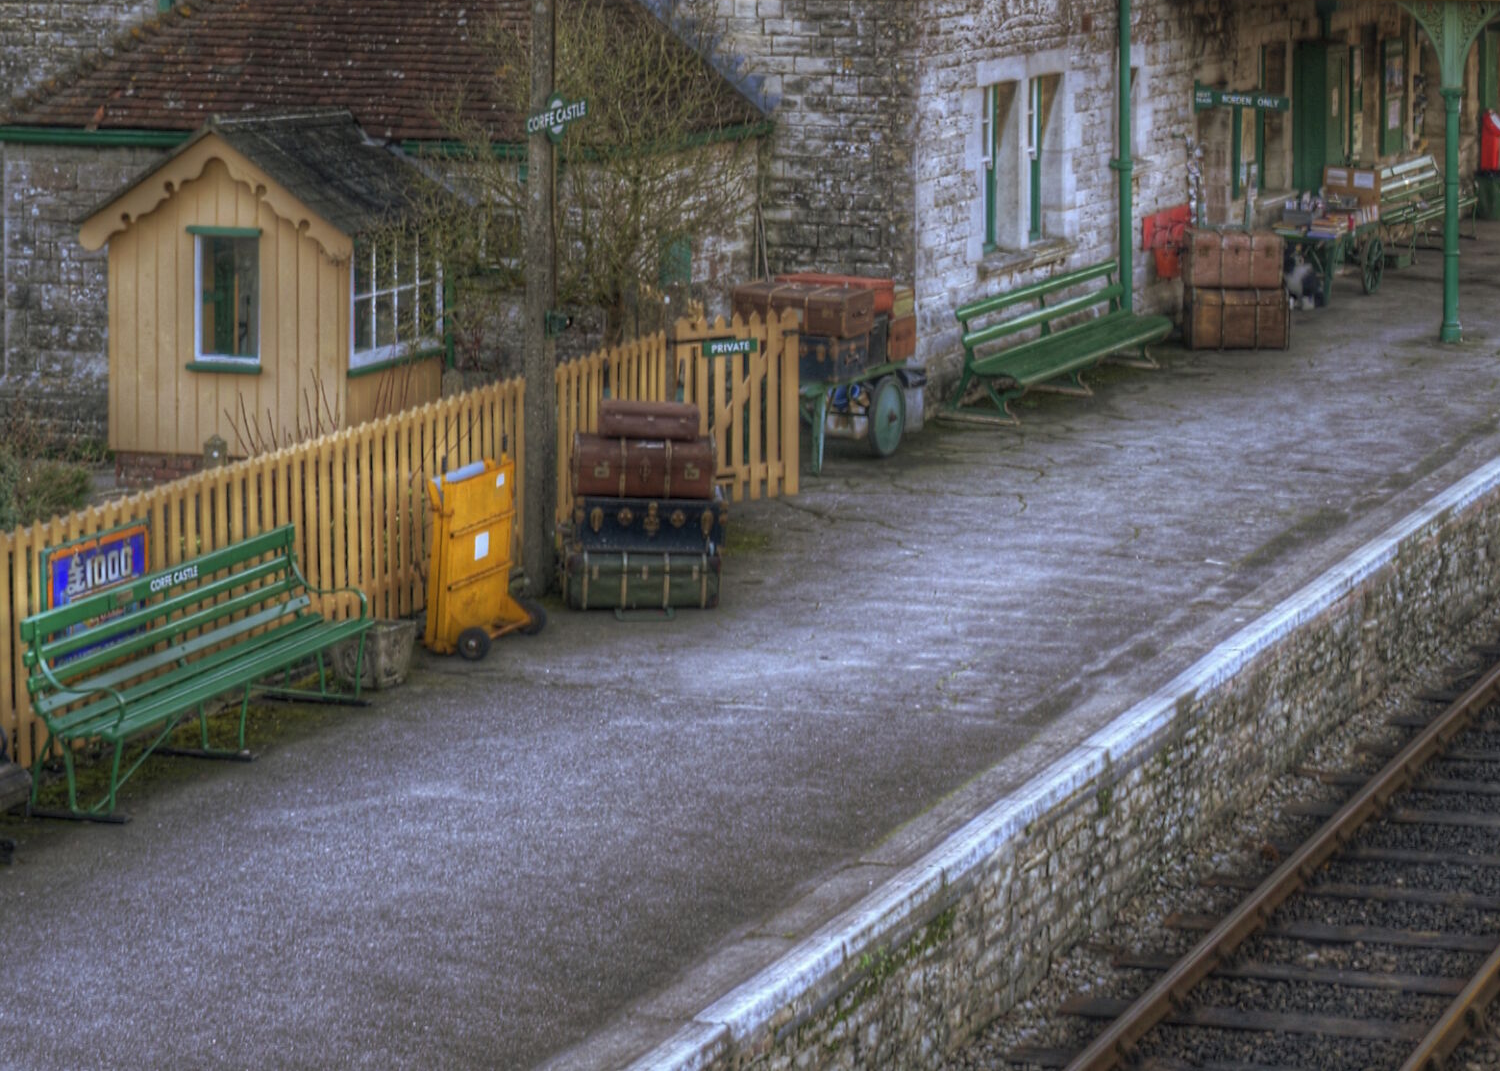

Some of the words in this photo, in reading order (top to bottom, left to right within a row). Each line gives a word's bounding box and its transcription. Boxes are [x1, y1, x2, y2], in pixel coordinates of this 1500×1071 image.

[528, 111, 555, 132] CORFE
[556, 100, 586, 123] CASTLE
[1257, 97, 1280, 108] ONLY
[711, 340, 750, 354] PRIVATE
[66, 545, 133, 595] £1000
[150, 574, 173, 592] CORFE
[173, 564, 198, 584] CASTLE
